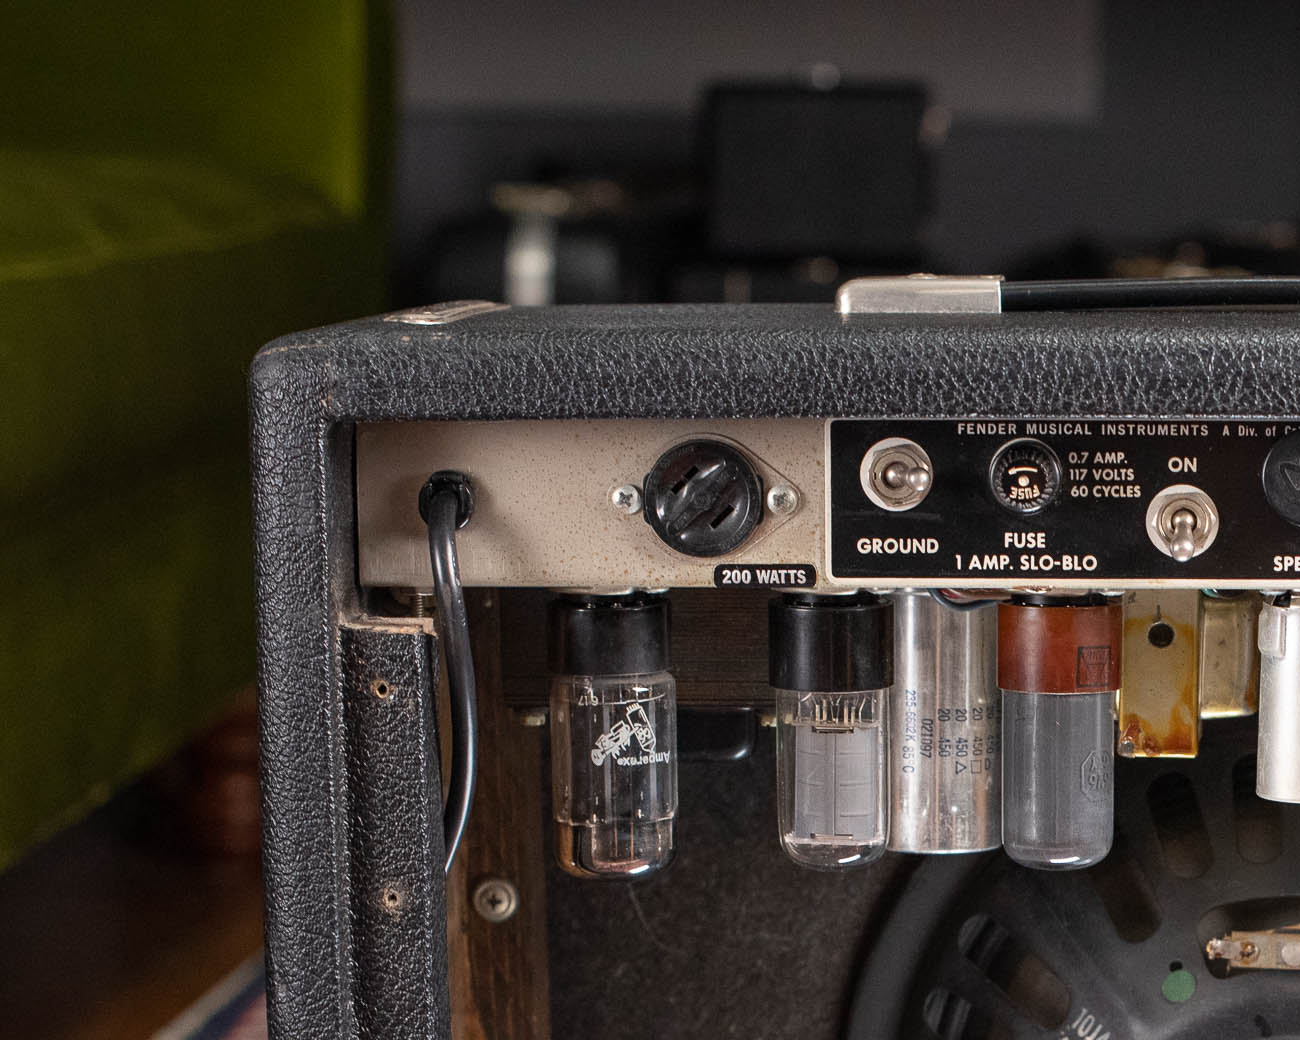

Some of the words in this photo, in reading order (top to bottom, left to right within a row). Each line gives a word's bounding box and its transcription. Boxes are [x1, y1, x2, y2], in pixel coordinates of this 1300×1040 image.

[957, 423, 1017, 436] FENDER
[1026, 423, 1093, 437] MUSICAL
[1101, 424, 1209, 437] INSTRUMENTS
[1222, 425, 1231, 437] A
[1238, 425, 1258, 437] Div.
[1265, 425, 1277, 437] of
[1068, 452, 1090, 464] 0.7
[1093, 452, 1128, 464] AMP.
[1168, 457, 1197, 473] ON
[1069, 468, 1089, 480] 117
[1093, 468, 1135, 481] VOLTS
[1009, 485, 1040, 500] FUSE
[1070, 485, 1089, 498] 60
[1093, 485, 1141, 498] CYCLES
[857, 537, 939, 555] GROUND
[1004, 532, 1046, 548] FUSE
[955, 554, 962, 570] 1
[969, 555, 1014, 570] AMP.
[1020, 555, 1098, 571] SLO-BLO
[722, 569, 752, 585] 200
[755, 569, 807, 585] WATTS
[938, 708, 951, 722] 20
[955, 708, 967, 722] 20
[972, 707, 983, 721] 20
[920, 718, 932, 758] 021097
[938, 737, 951, 757] 450
[955, 737, 968, 757] 450
[973, 736, 983, 756] 450
